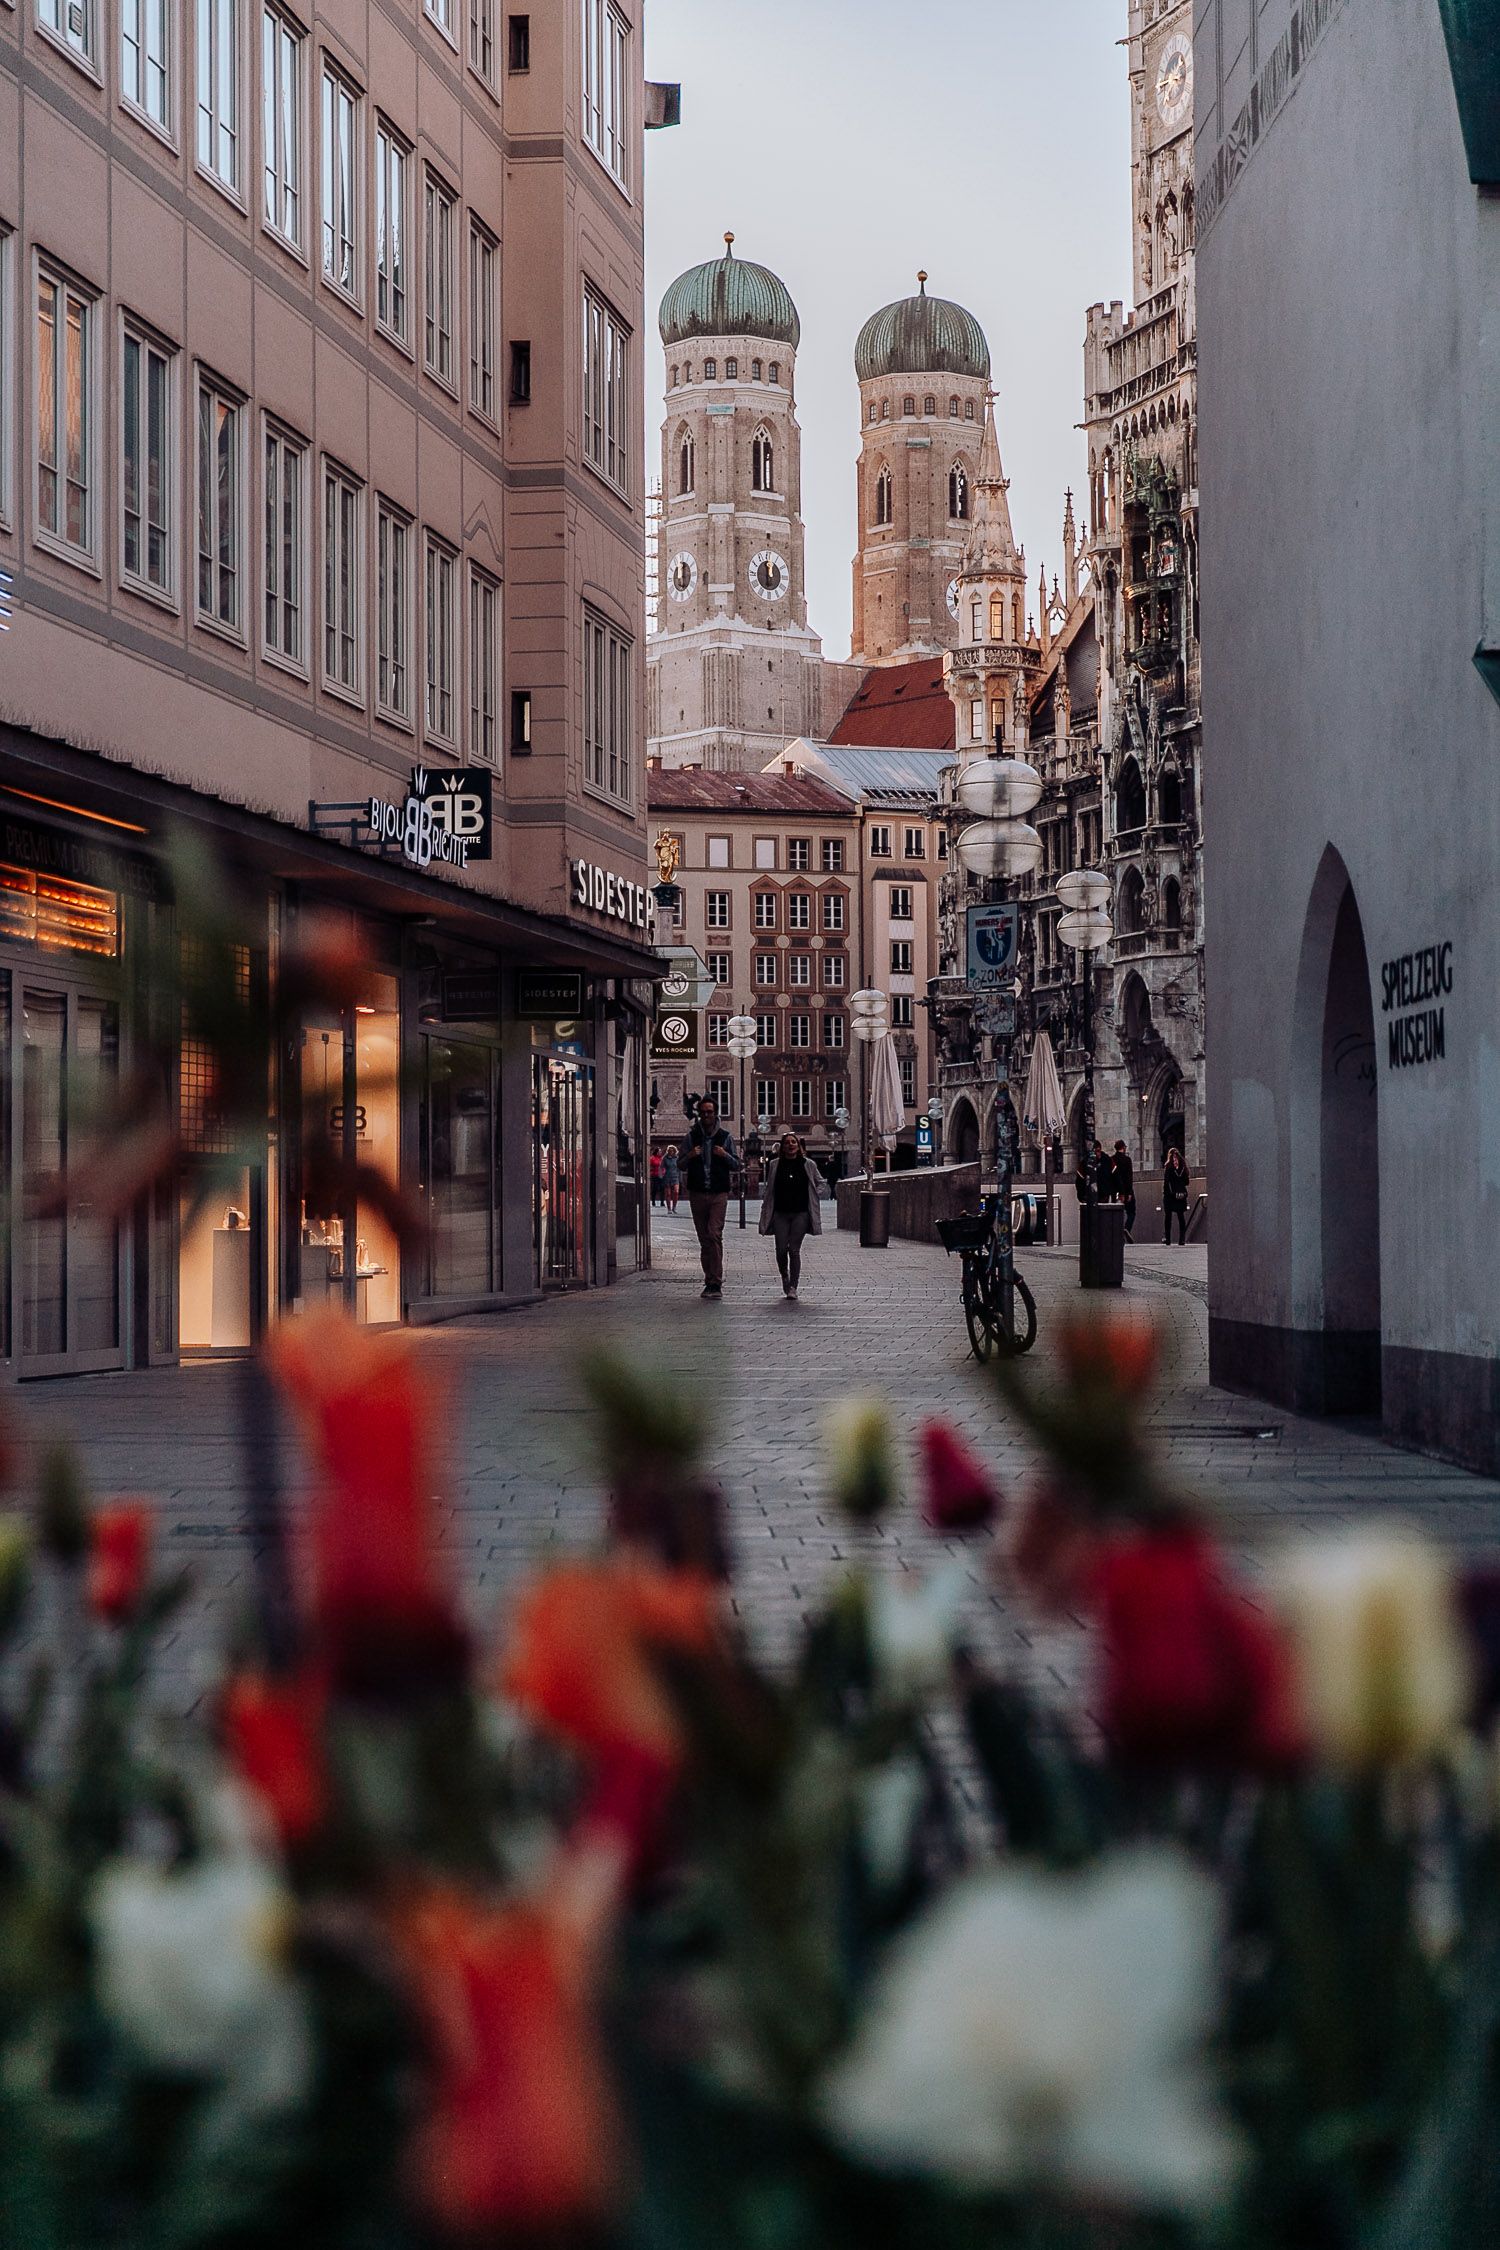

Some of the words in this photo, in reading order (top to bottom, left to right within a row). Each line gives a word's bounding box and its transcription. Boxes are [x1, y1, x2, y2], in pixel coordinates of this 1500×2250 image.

[578, 858, 654, 930] SIDESTEP
[523, 988, 577, 999] SIDESTEP
[1381, 941, 1452, 1012] SPIELZEUG
[1388, 1006, 1445, 1070] MUSEUM
[919, 1116, 930, 1129] S
[919, 1131, 929, 1144] U
